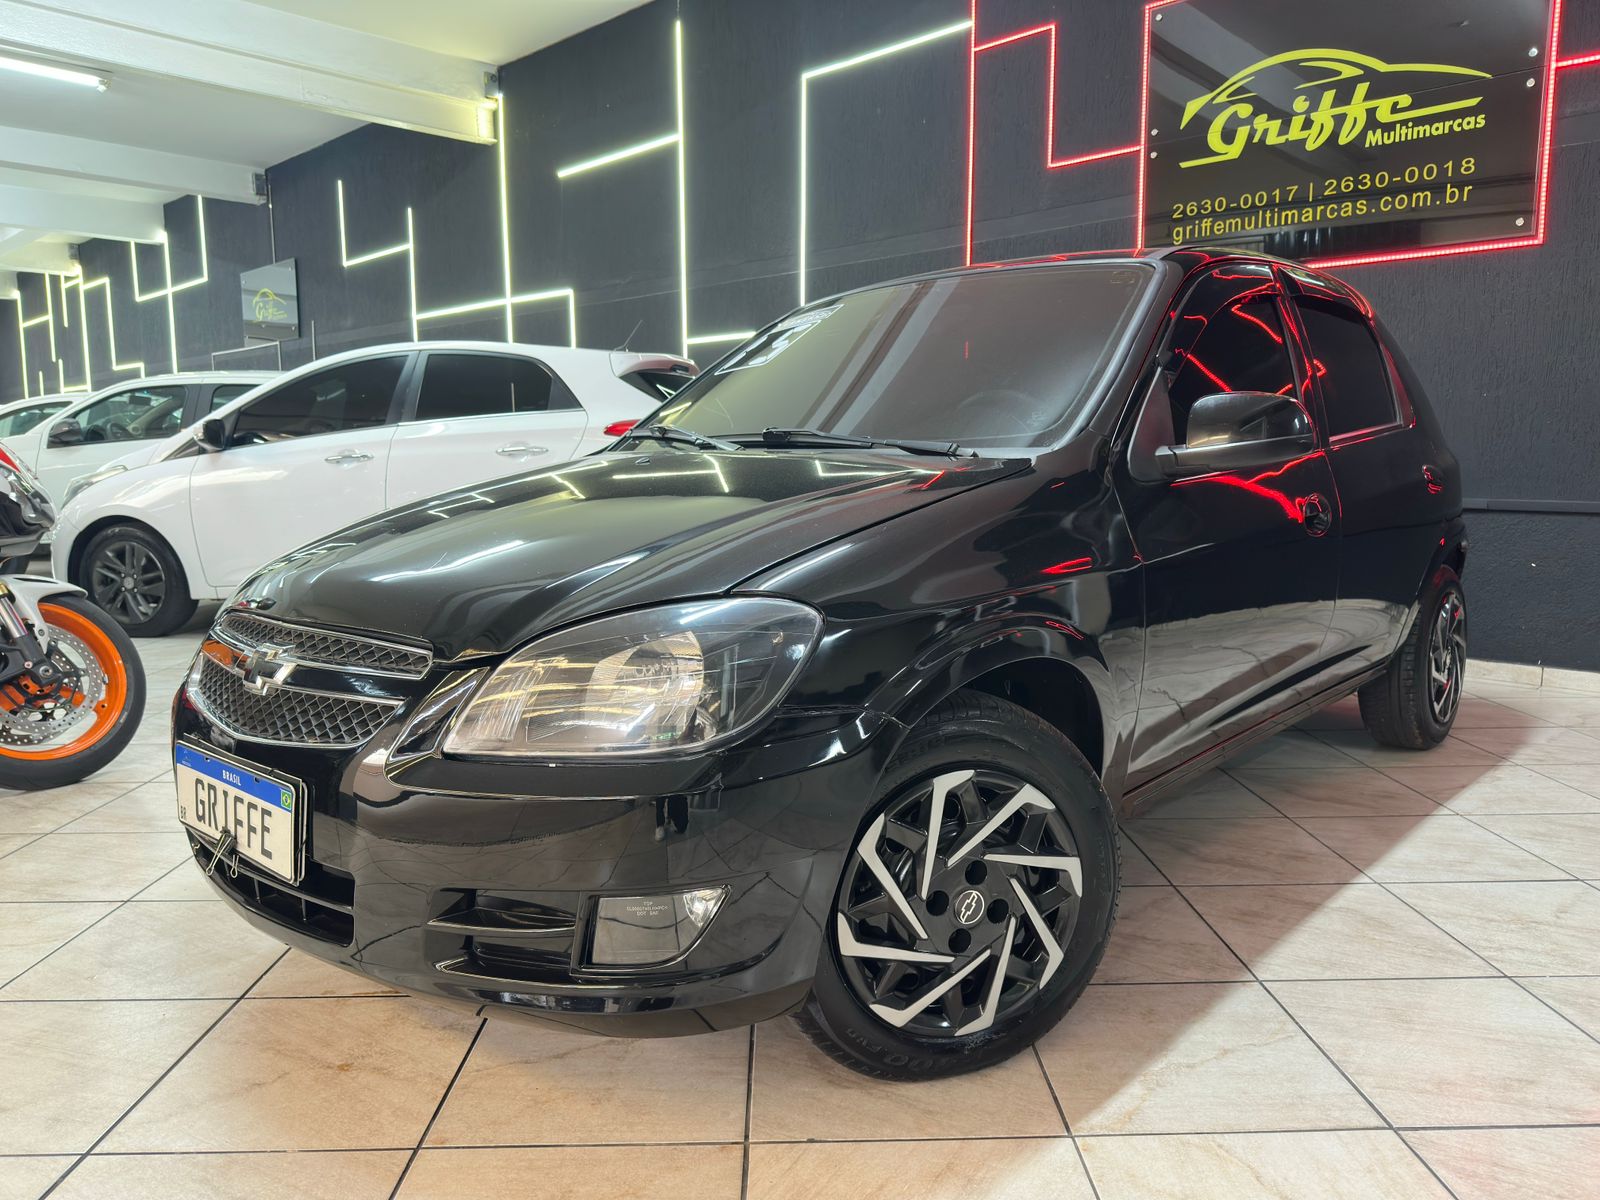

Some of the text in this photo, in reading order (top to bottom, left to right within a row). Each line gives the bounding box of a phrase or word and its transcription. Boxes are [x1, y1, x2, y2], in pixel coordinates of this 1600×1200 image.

[1179, 81, 1483, 168] Griffe
[1364, 114, 1486, 148] Multimarcas
[1172, 185, 1299, 219] 2630-0017
[1323, 157, 1476, 196] 2630-0018
[1172, 184, 1473, 246] griffemultimarcas.com.br
[222, 769, 242, 786] BRASIL
[194, 777, 273, 861] GRIFFE
